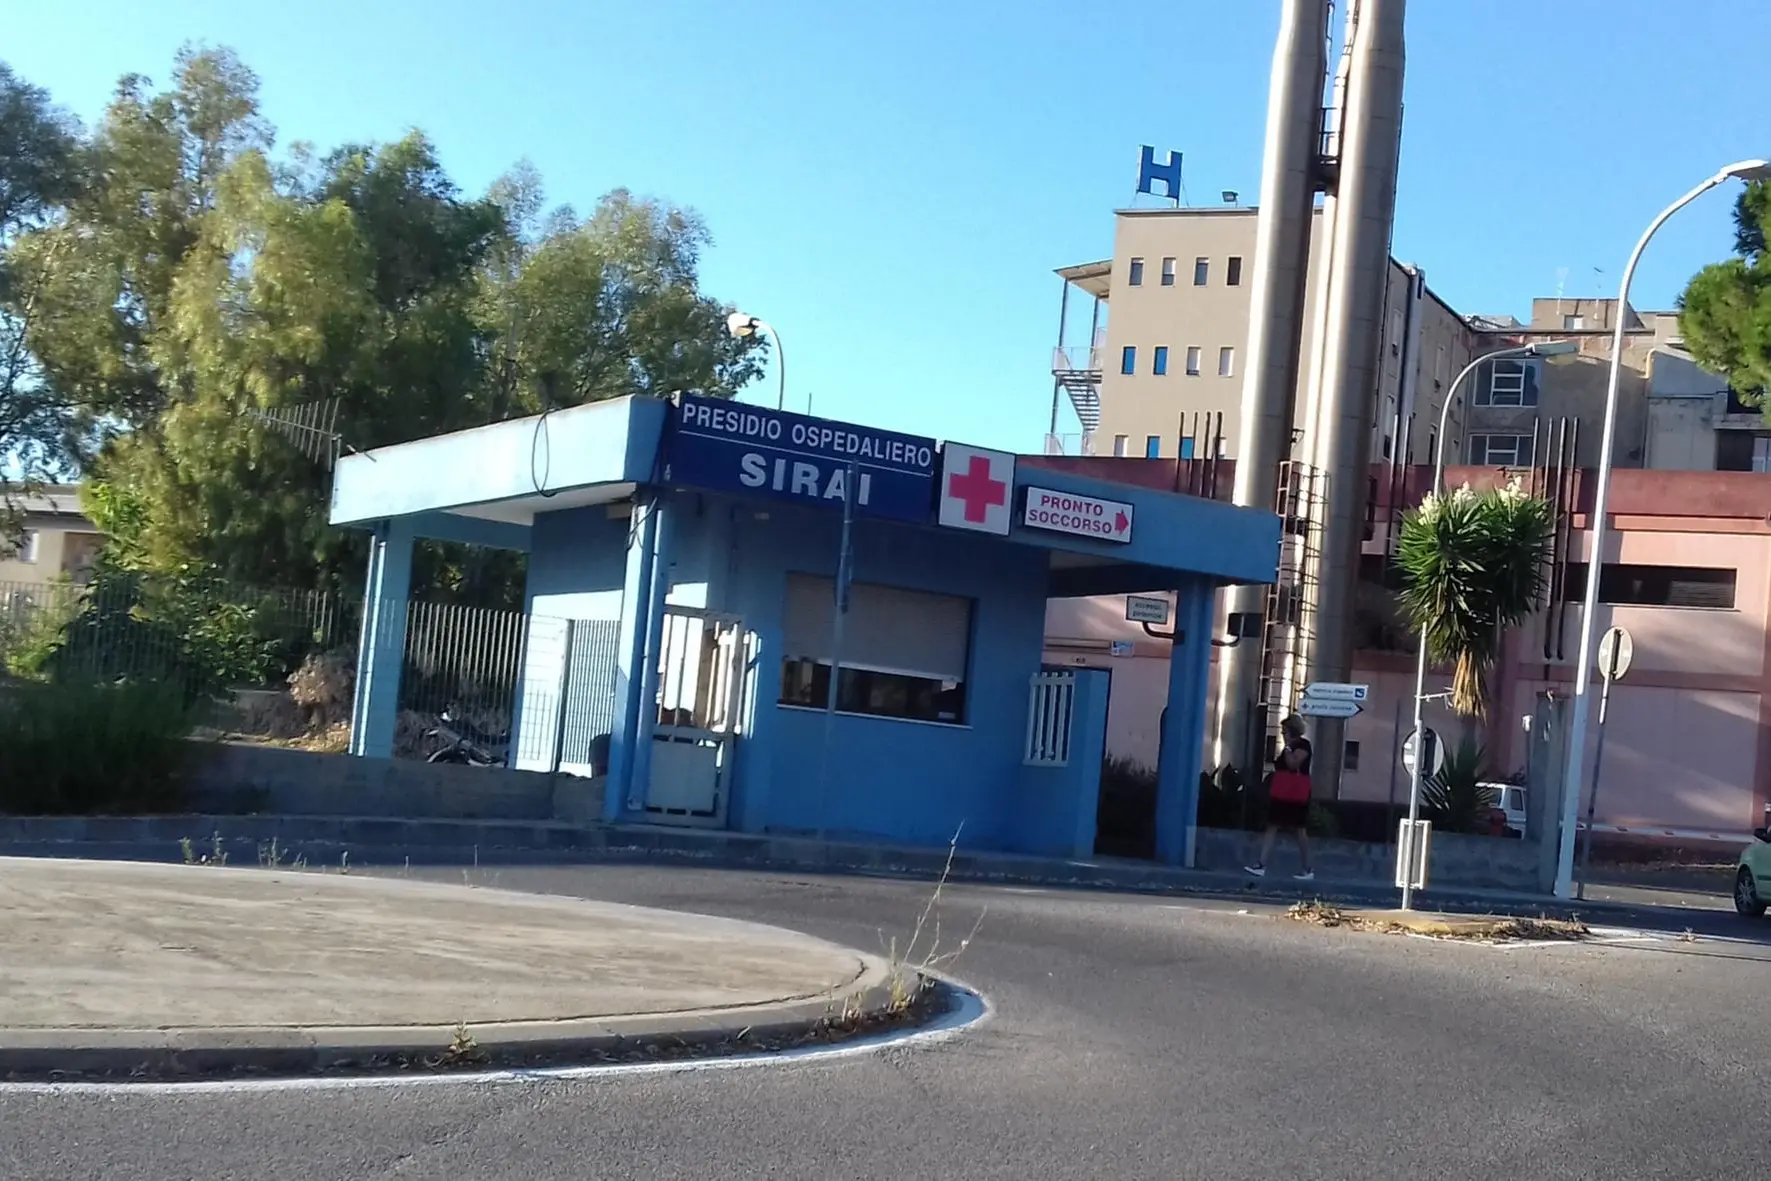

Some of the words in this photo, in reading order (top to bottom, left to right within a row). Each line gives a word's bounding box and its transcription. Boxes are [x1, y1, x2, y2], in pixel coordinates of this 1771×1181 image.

[1139, 145, 1183, 199] H
[682, 403, 781, 440] PRESIDIO
[792, 423, 931, 467] OSPEDALIERO
[740, 453, 871, 505] SIRAI
[1028, 509, 1112, 534] SOCCORSO
[1041, 495, 1103, 516] PRONTO
